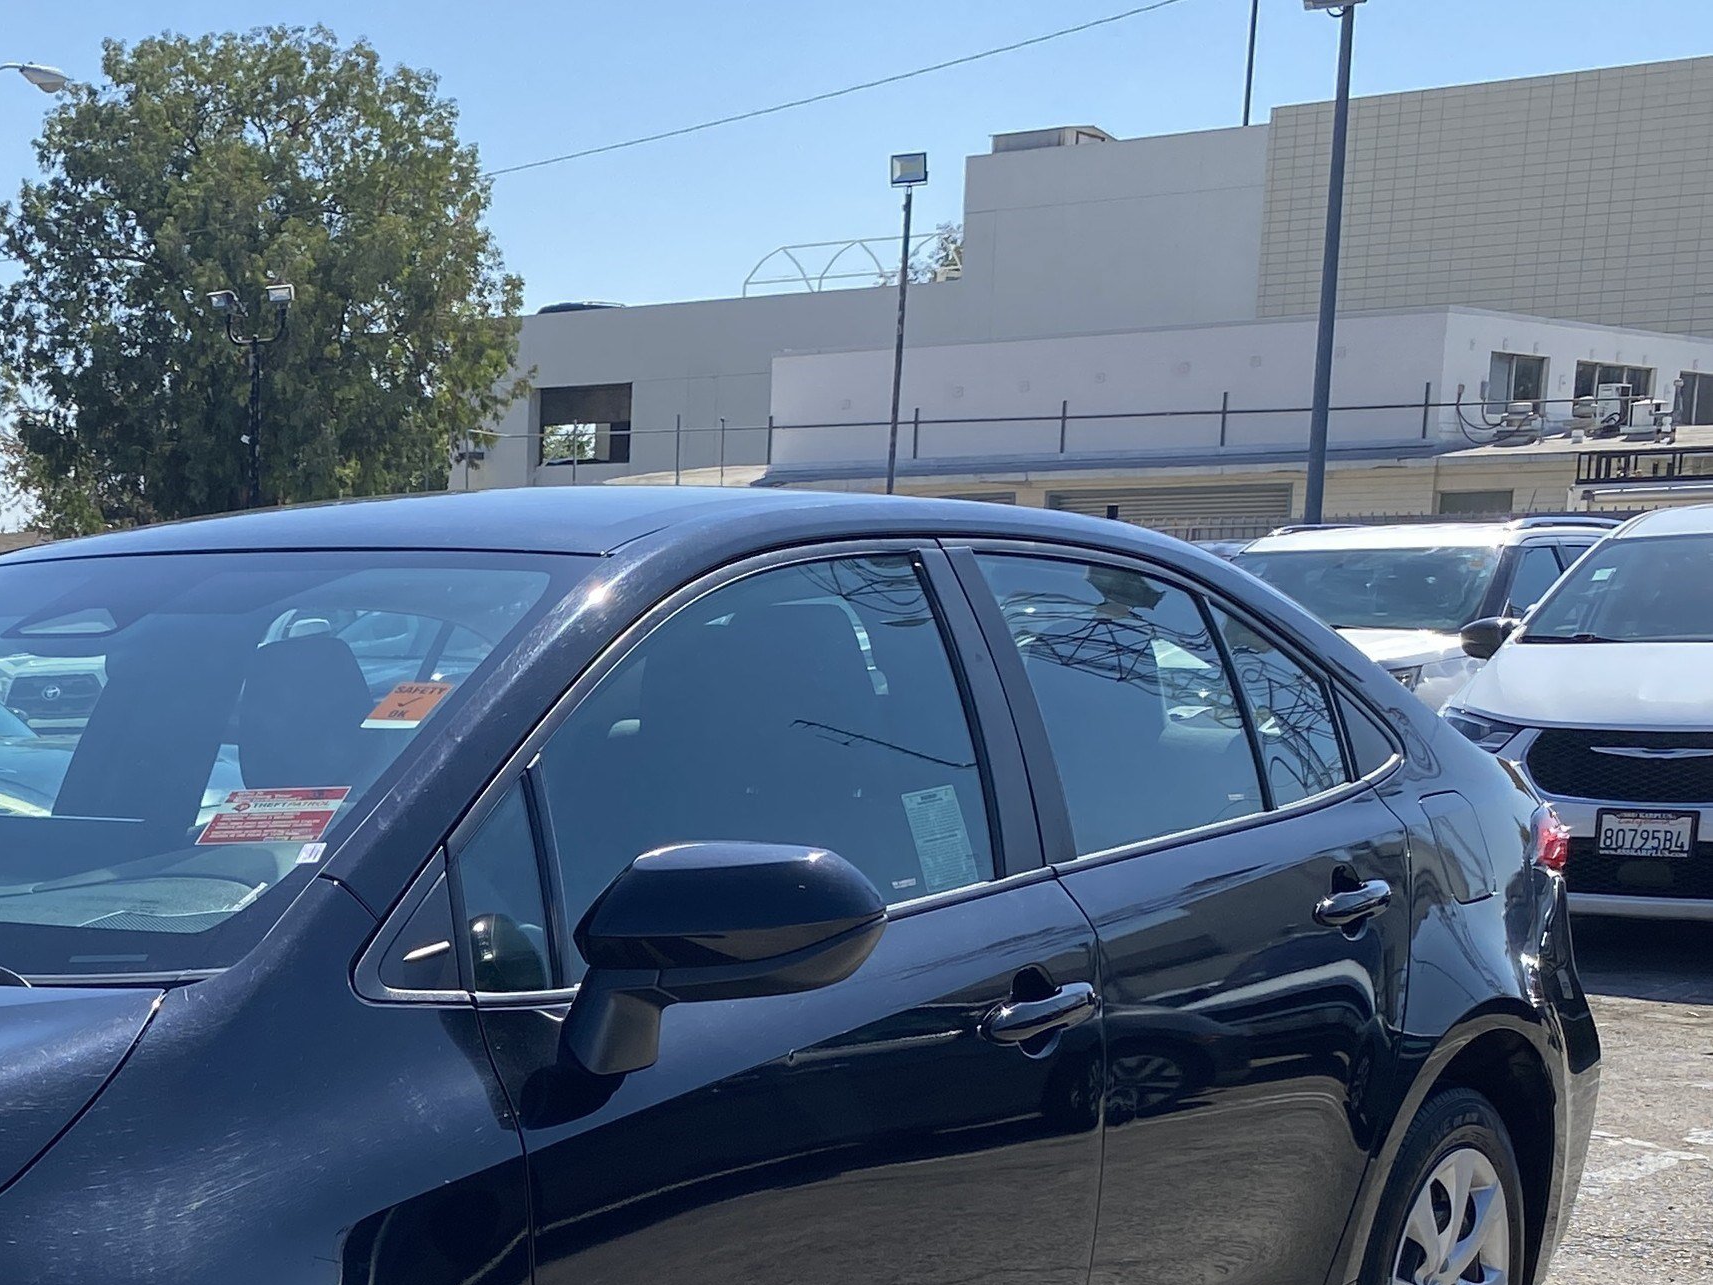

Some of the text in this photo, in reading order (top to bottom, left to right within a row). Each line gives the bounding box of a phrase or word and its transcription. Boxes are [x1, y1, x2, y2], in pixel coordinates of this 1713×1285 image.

[394, 685, 448, 695] SAFETY
[388, 709, 410, 718] OK
[1603, 828, 1685, 849] 80795B4
